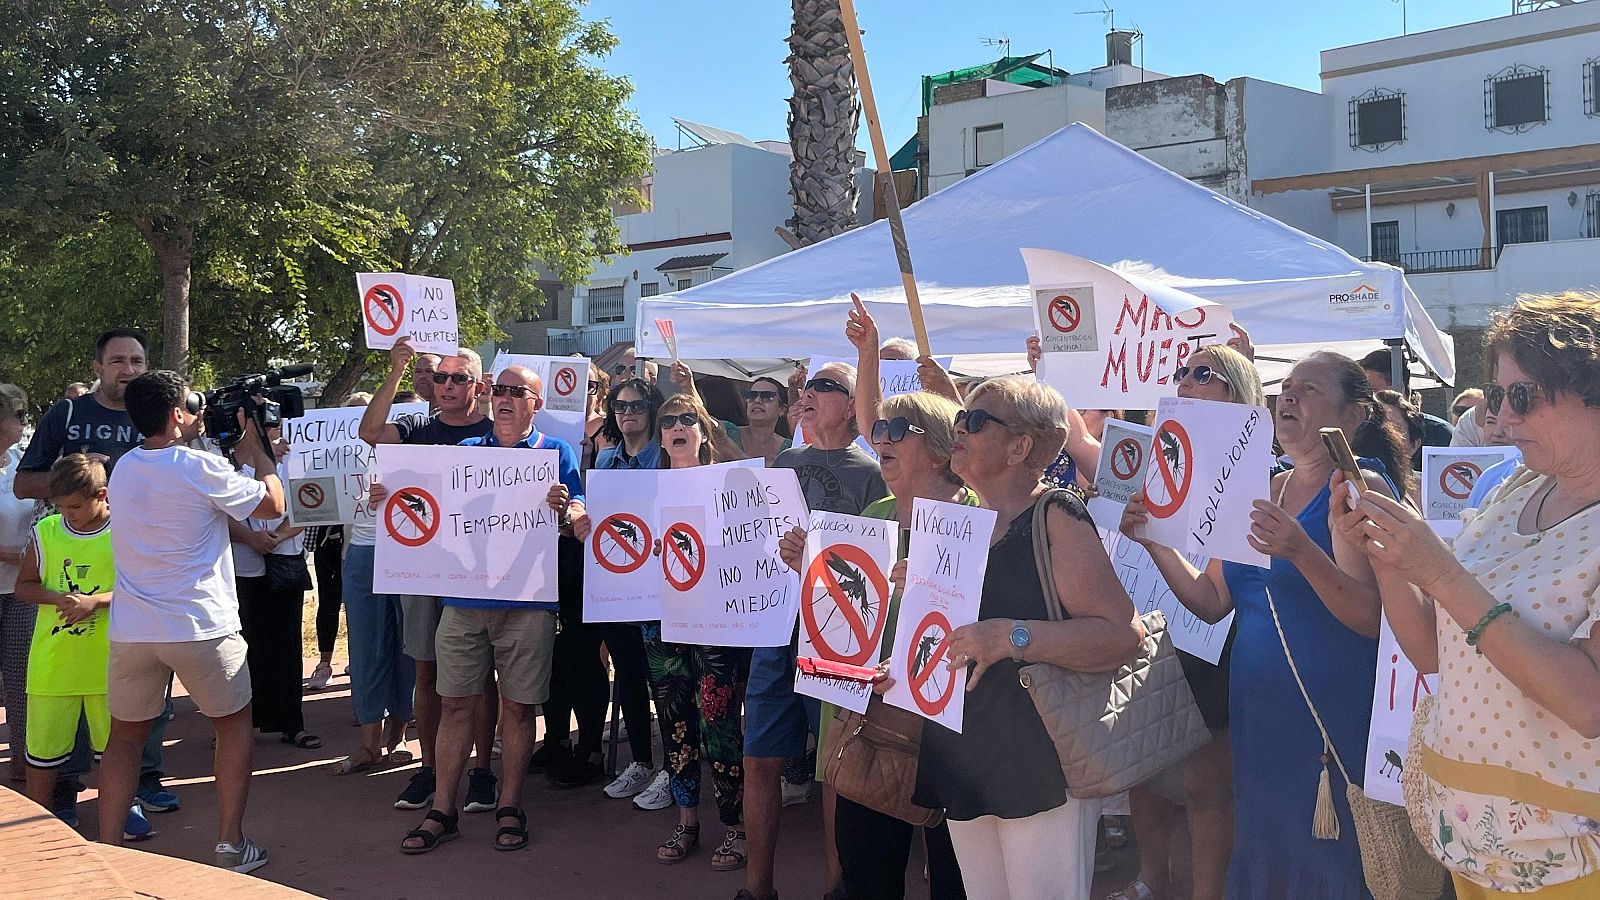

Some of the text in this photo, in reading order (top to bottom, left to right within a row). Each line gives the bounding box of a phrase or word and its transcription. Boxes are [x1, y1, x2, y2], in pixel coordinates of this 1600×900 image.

[1329, 293, 1380, 302] PROSHADE
[411, 306, 449, 323] MÁS
[299, 444, 378, 473] TEMPRA
[746, 481, 781, 508] MÁS
